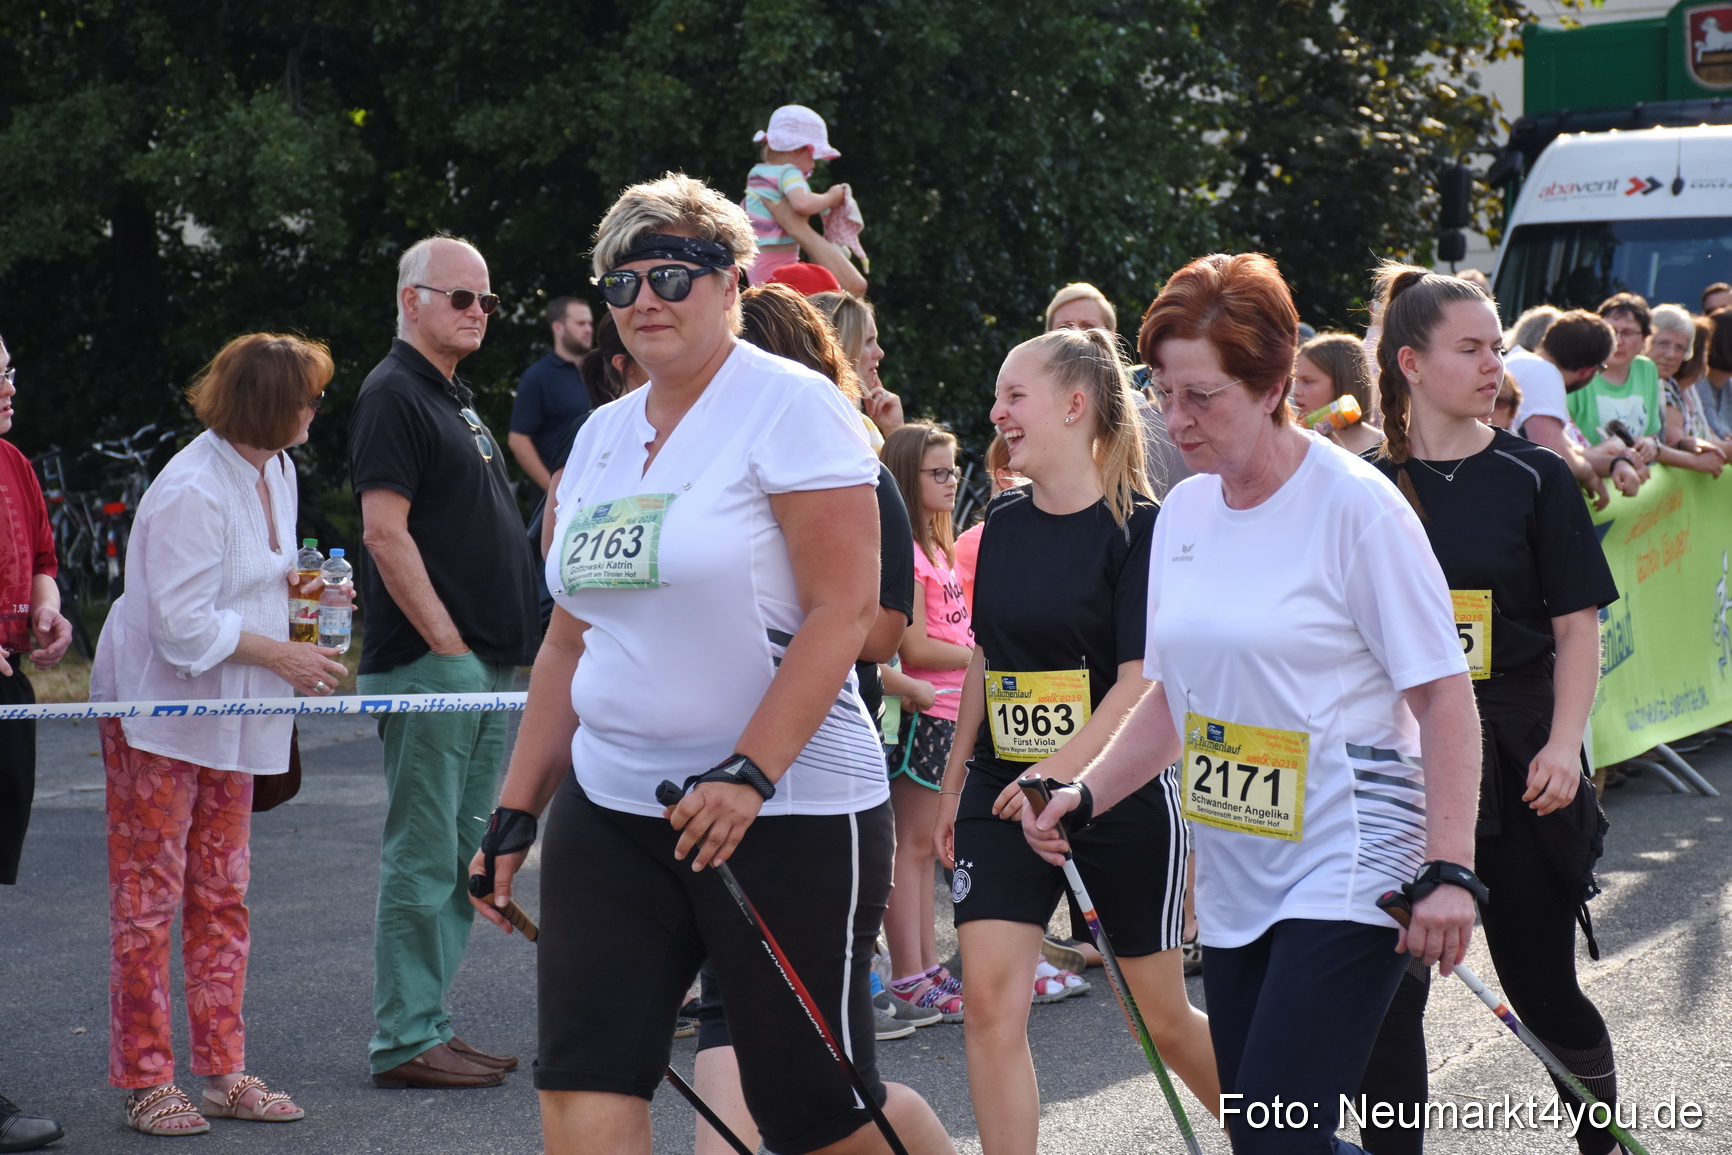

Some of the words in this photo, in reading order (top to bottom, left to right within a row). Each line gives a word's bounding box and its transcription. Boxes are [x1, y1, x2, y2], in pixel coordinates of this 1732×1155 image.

[1538, 179, 1619, 199] abavent
[567, 525, 644, 566] 2163
[604, 570, 623, 578] Tiroler
[606, 560, 633, 570] Katrin
[1038, 692, 1059, 703] walk
[1060, 694, 1082, 703] 2019
[998, 704, 1075, 736] 1963
[1013, 738, 1032, 746] Fürst
[1034, 738, 1056, 746] Viola
[1200, 736, 1242, 755] firmenlauf
[1247, 753, 1271, 766] walk
[1271, 759, 1299, 769] 2019
[1193, 754, 1280, 807] 2171
[1191, 792, 1243, 812] Schwandner
[1245, 805, 1290, 820] Angelika
[1197, 805, 1232, 820] Seniorenstift
[1244, 815, 1266, 826] Tiroler
[1267, 820, 1280, 828] Hof
